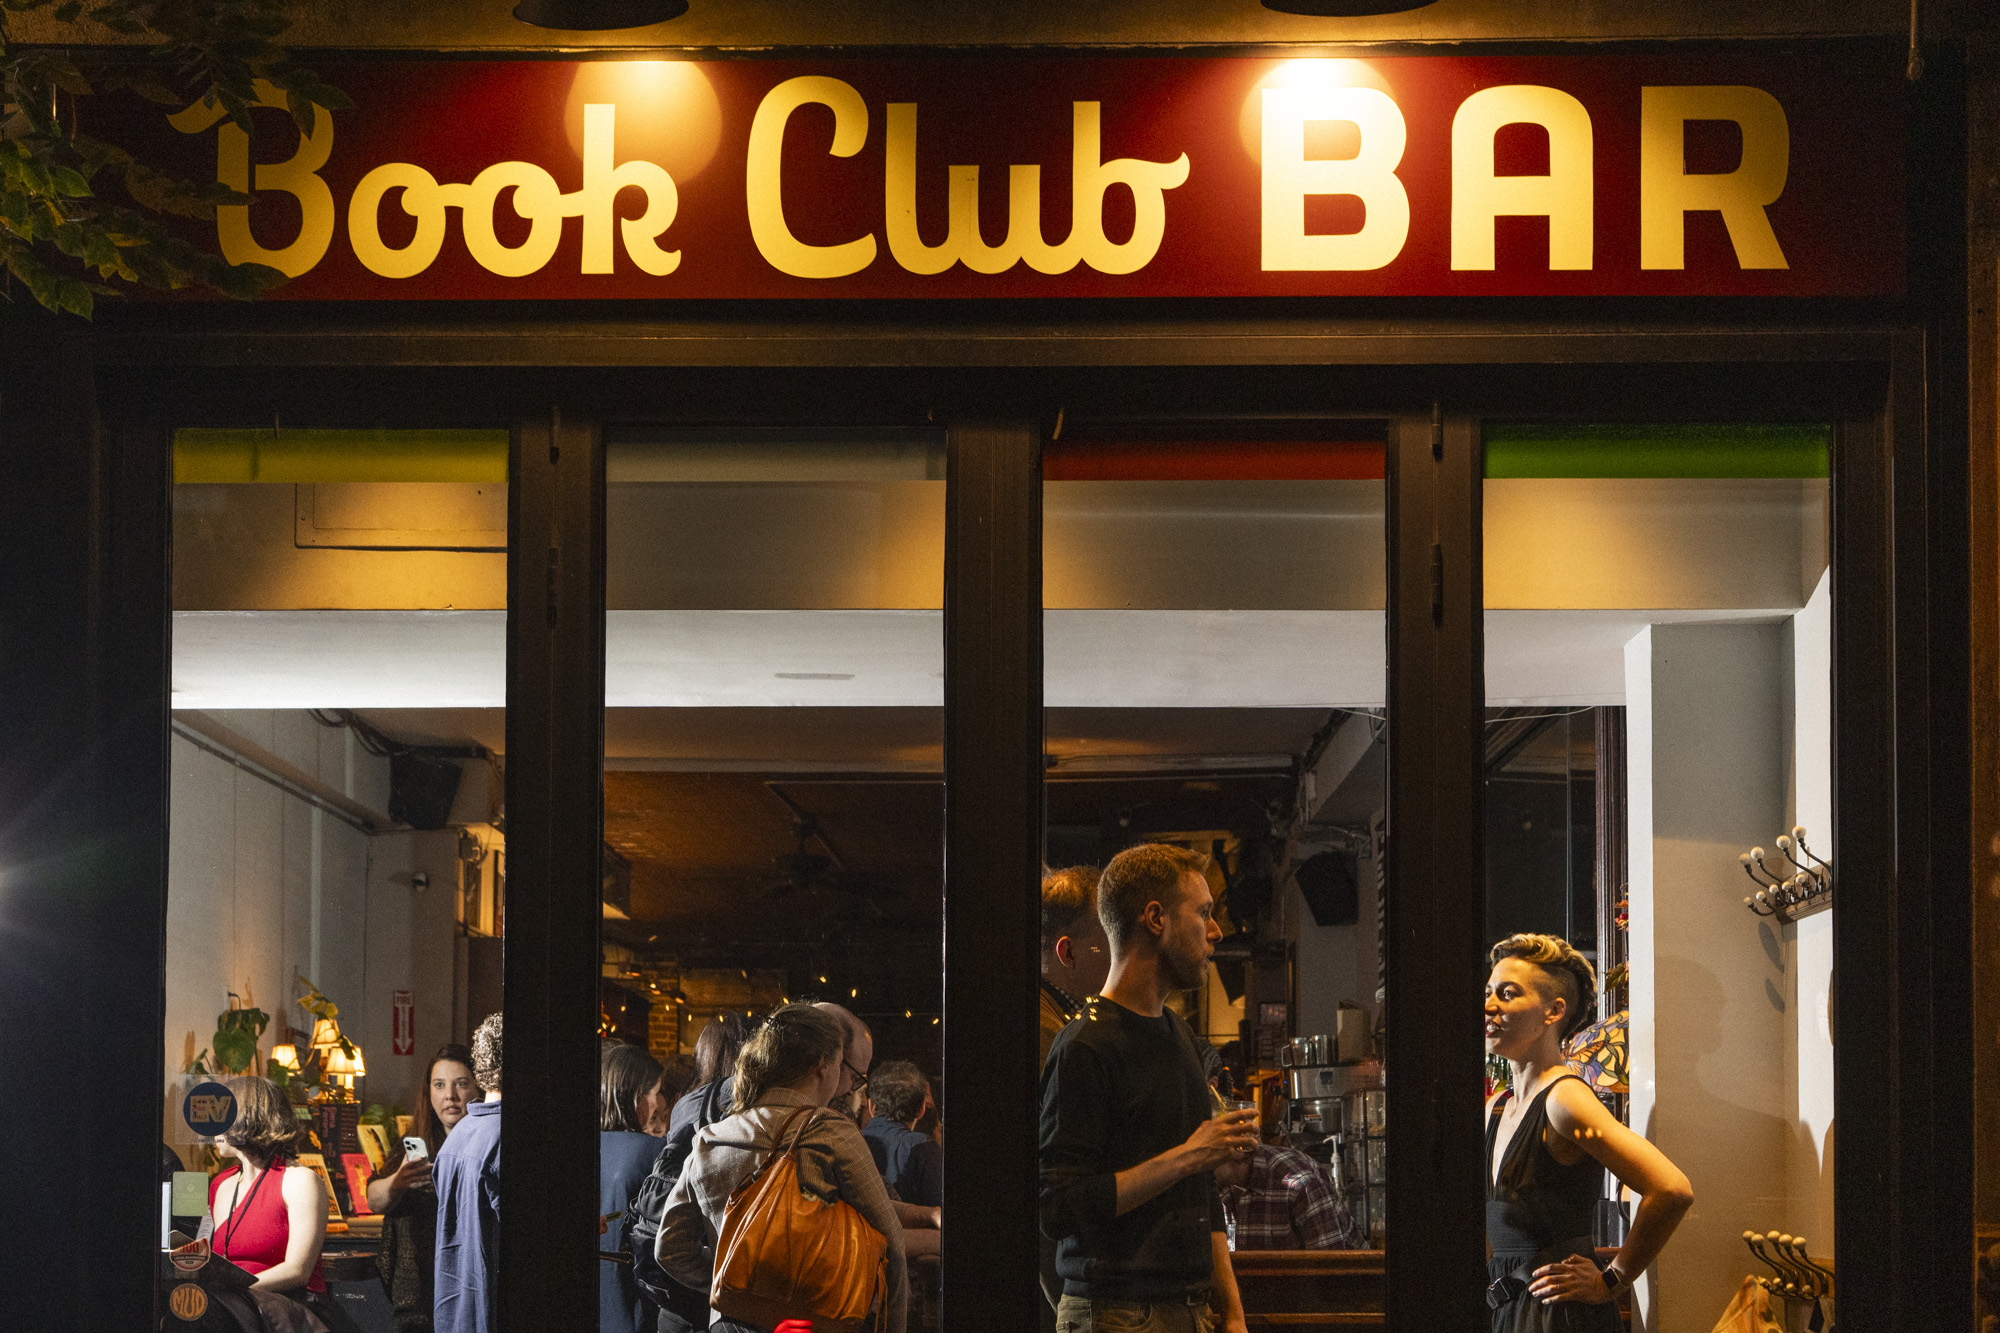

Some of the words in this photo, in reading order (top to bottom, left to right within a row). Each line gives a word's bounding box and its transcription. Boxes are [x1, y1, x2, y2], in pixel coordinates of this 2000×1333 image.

[167, 77, 682, 279] Book
[745, 75, 1191, 278] Club
[1260, 84, 1791, 272] BAR
[173, 1287, 206, 1318] MUD
